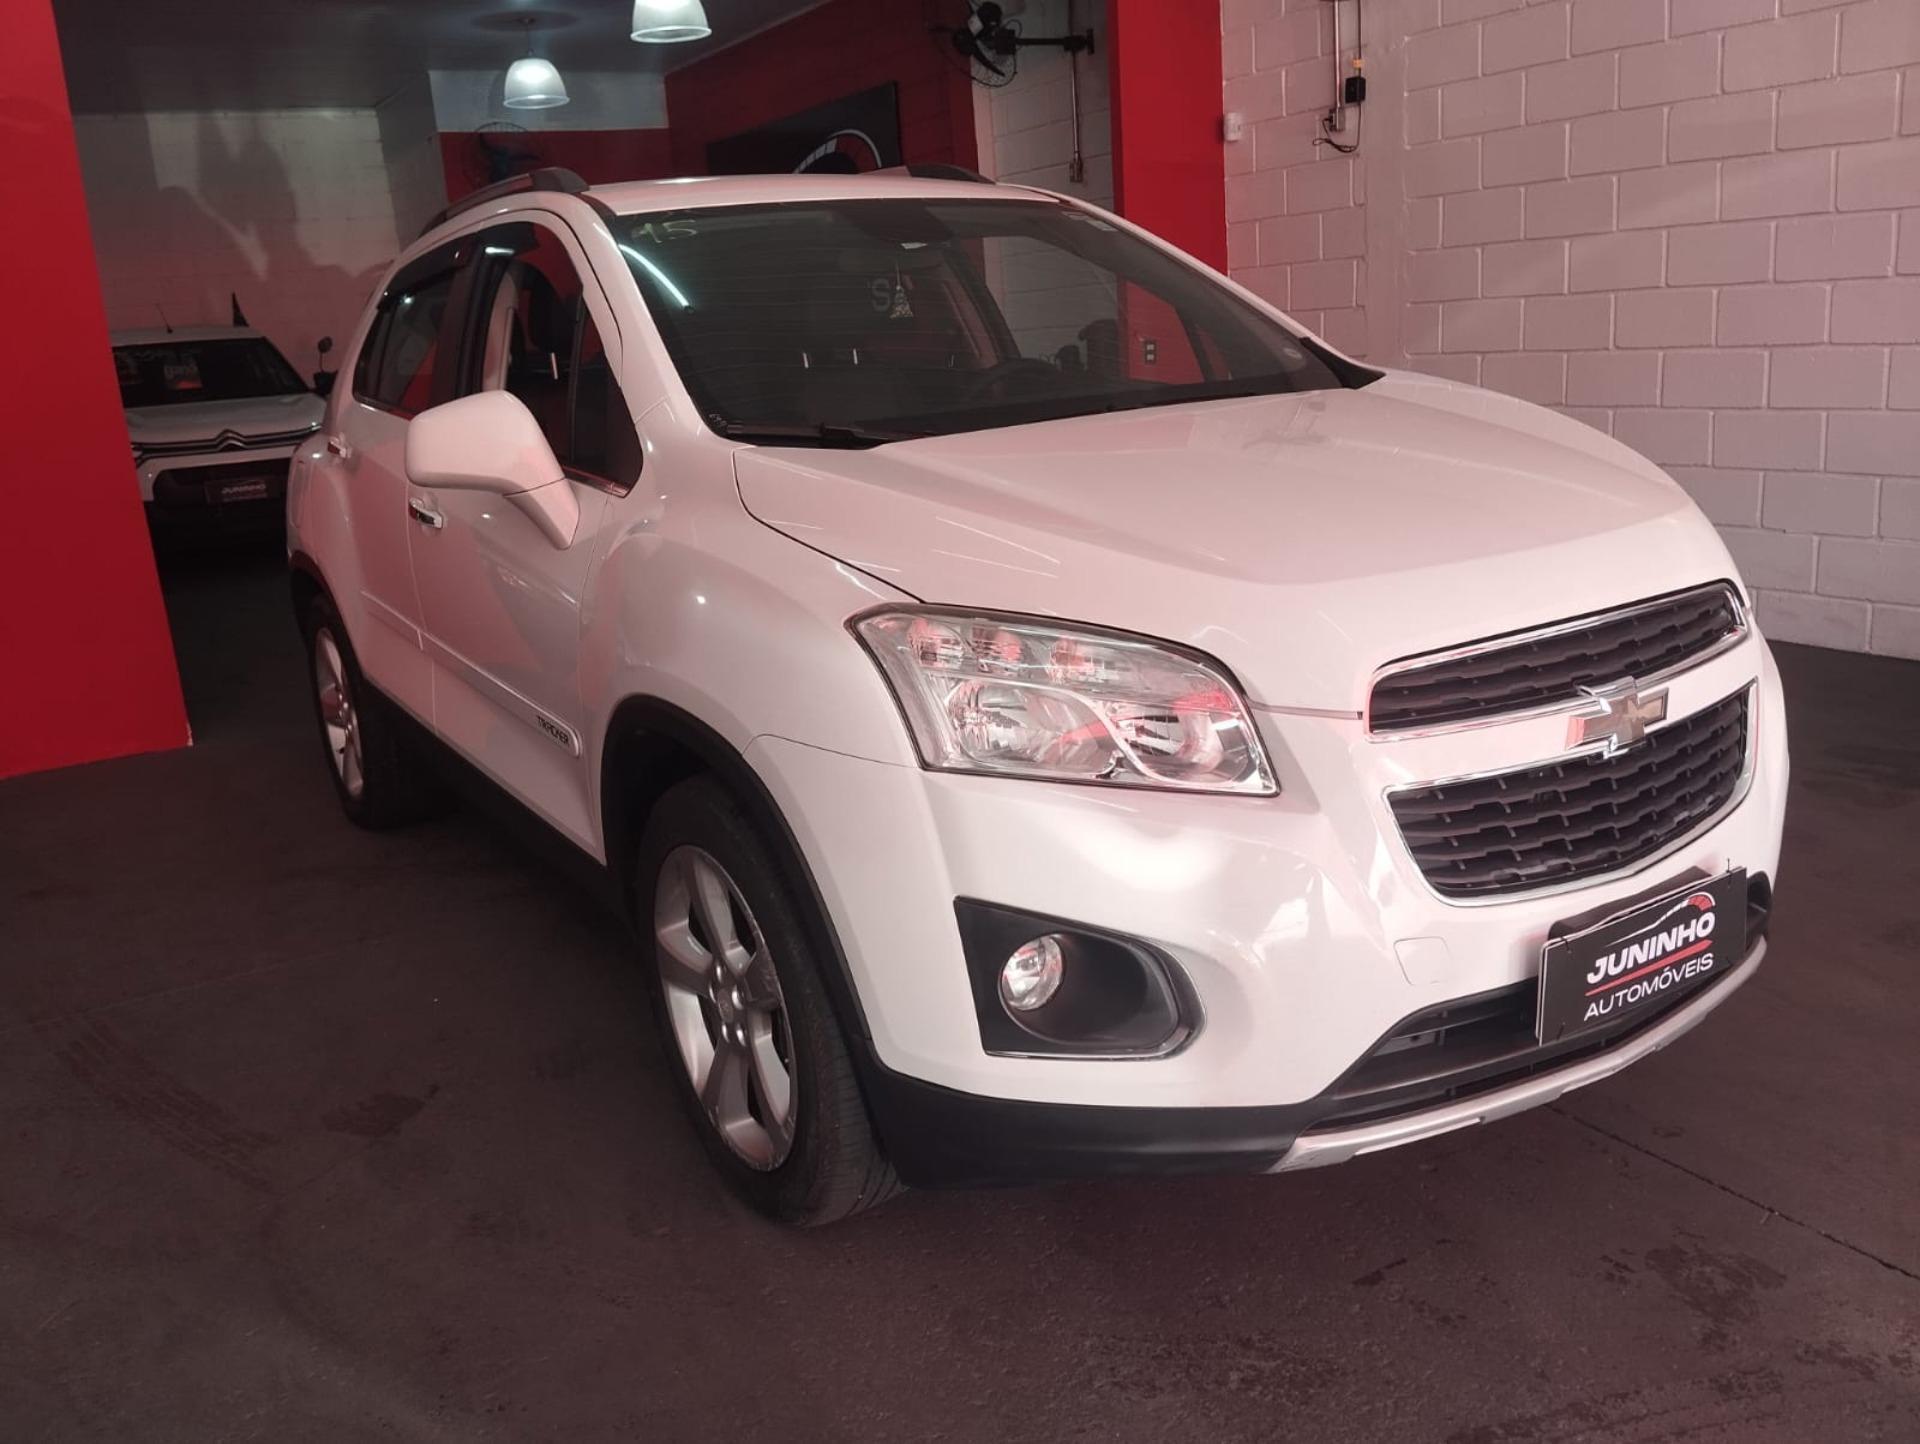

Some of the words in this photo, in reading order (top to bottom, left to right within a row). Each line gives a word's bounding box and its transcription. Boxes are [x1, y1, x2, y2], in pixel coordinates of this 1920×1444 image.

[535, 714, 570, 746] TRACKER
[1586, 911, 1716, 985] JUNINHO
[1583, 952, 1714, 1022] AUTOMÓVEIS
